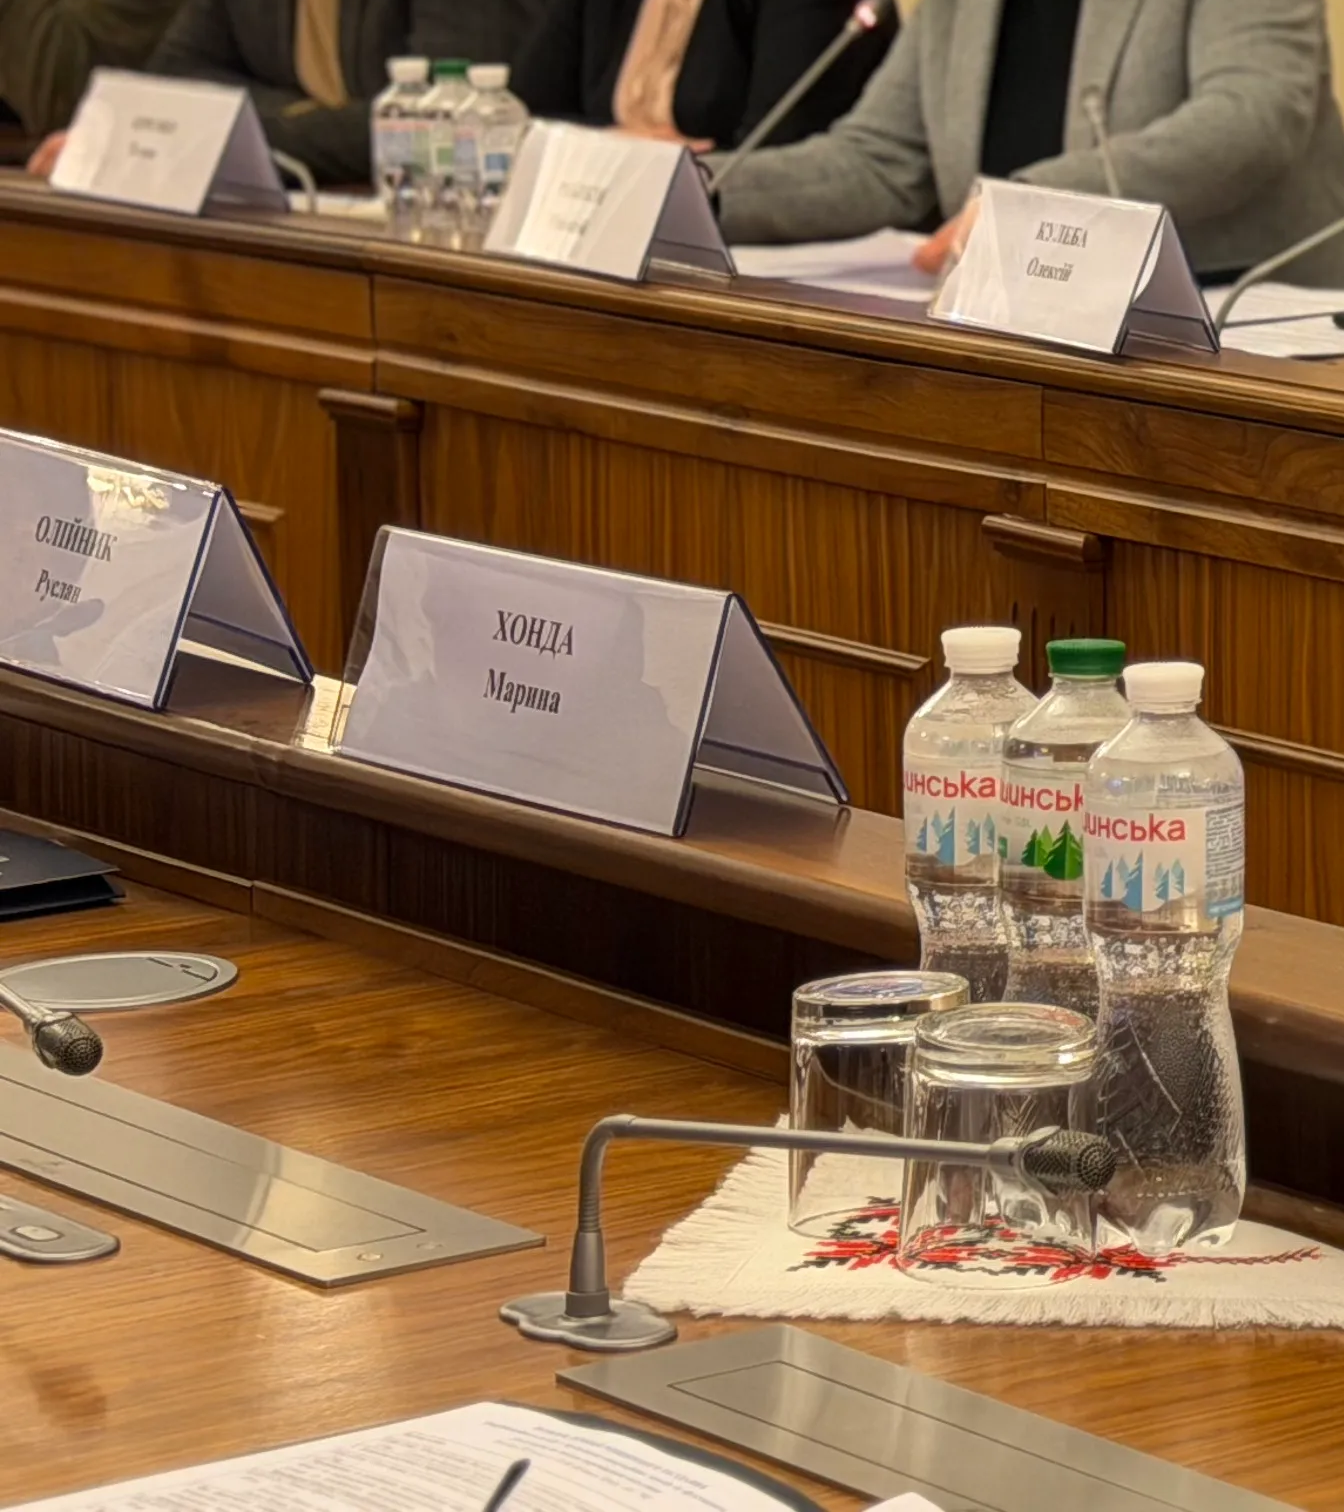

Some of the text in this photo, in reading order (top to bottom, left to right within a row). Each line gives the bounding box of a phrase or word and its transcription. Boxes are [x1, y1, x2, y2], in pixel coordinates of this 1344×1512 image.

[1036, 221, 1088, 248] КУЛЕБА
[1026, 257, 1074, 281] Олексій
[35, 515, 118, 562] ОЛІЙНИК
[35, 569, 81, 604] Руслан
[493, 610, 575, 660] ХОНДА
[483, 668, 561, 714] Марина
